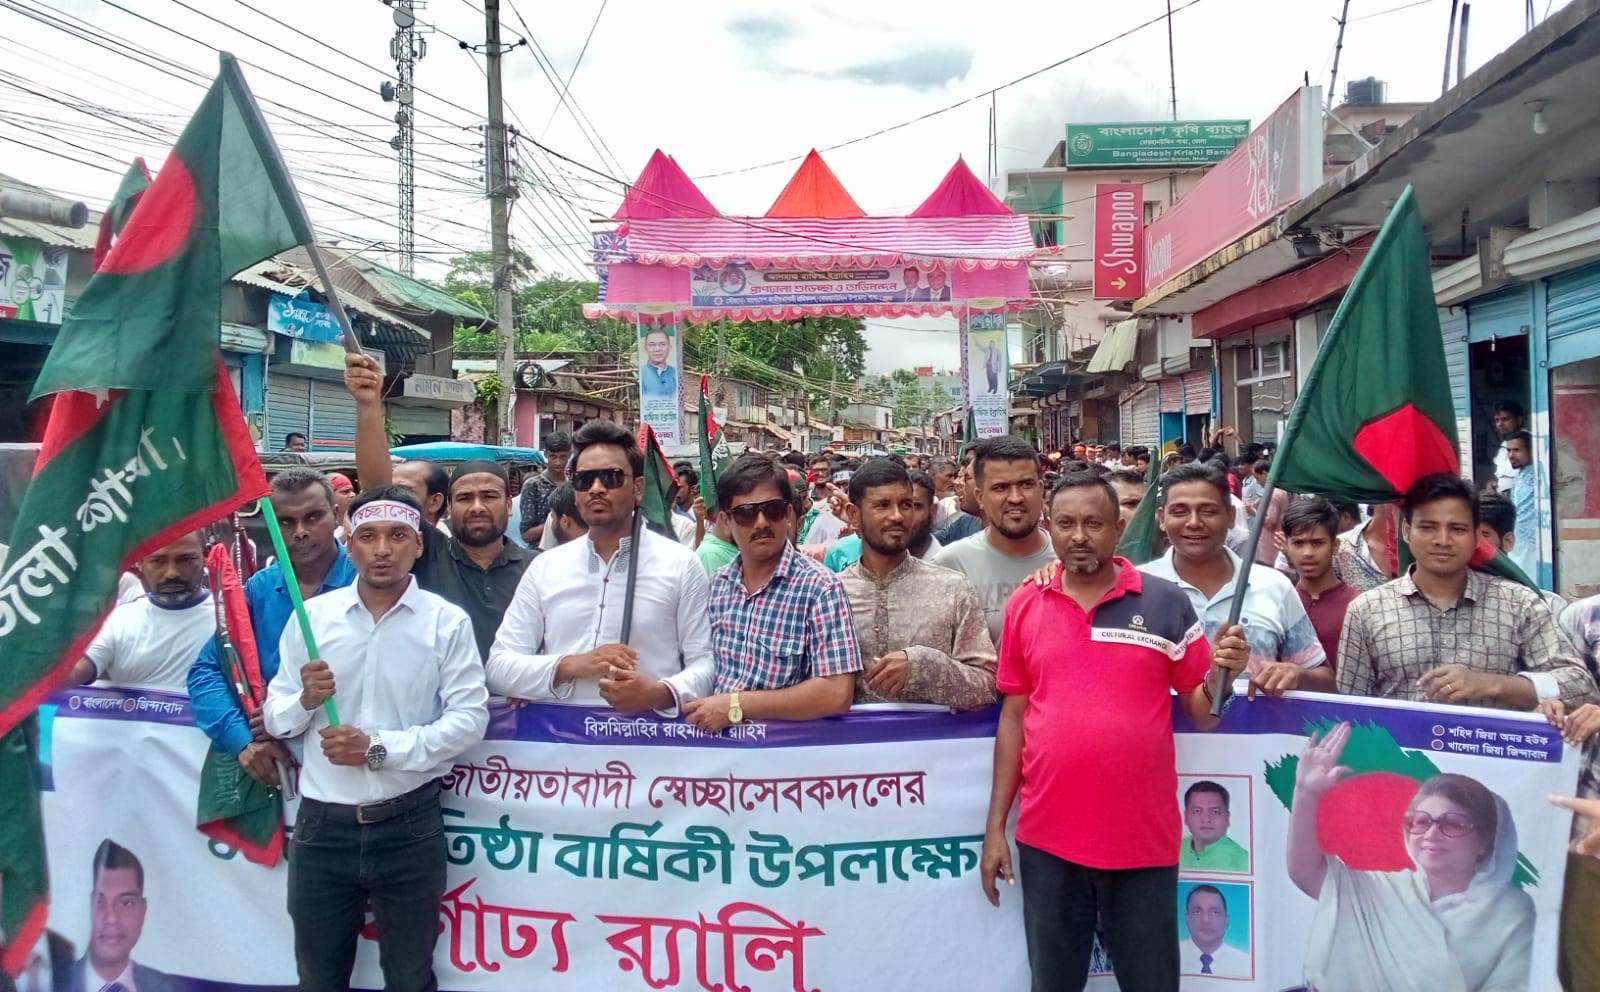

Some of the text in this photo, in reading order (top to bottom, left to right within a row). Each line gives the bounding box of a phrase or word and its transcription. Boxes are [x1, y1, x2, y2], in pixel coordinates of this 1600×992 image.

[1098, 127, 1168, 136] বাংলাদেশ
[1170, 124, 1200, 137] কৃষি
[1204, 125, 1247, 135] ব্যাংক
[1112, 150, 1171, 158] Bangladesh
[1173, 149, 1203, 157] Krishi
[1100, 191, 1139, 274] Shwapno
[1101, 631, 1135, 640] CULTURAL
[135, 697, 184, 715] জিন্দাবাদ
[584, 717, 658, 739] বিসমিল্লাহির
[729, 720, 767, 741] রাহিম
[1448, 726, 1548, 746] শহিদ জিয়া অমর হউক
[1448, 740, 1548, 761] খালেদা জিয়া জিন্দাবাদ
[440, 755, 928, 816] জাতীয়তাবাদী স্বেচ্ছাসেবকদলের
[553, 821, 735, 885] বার্ষিকী
[746, 831, 985, 888] উপলক্ষে
